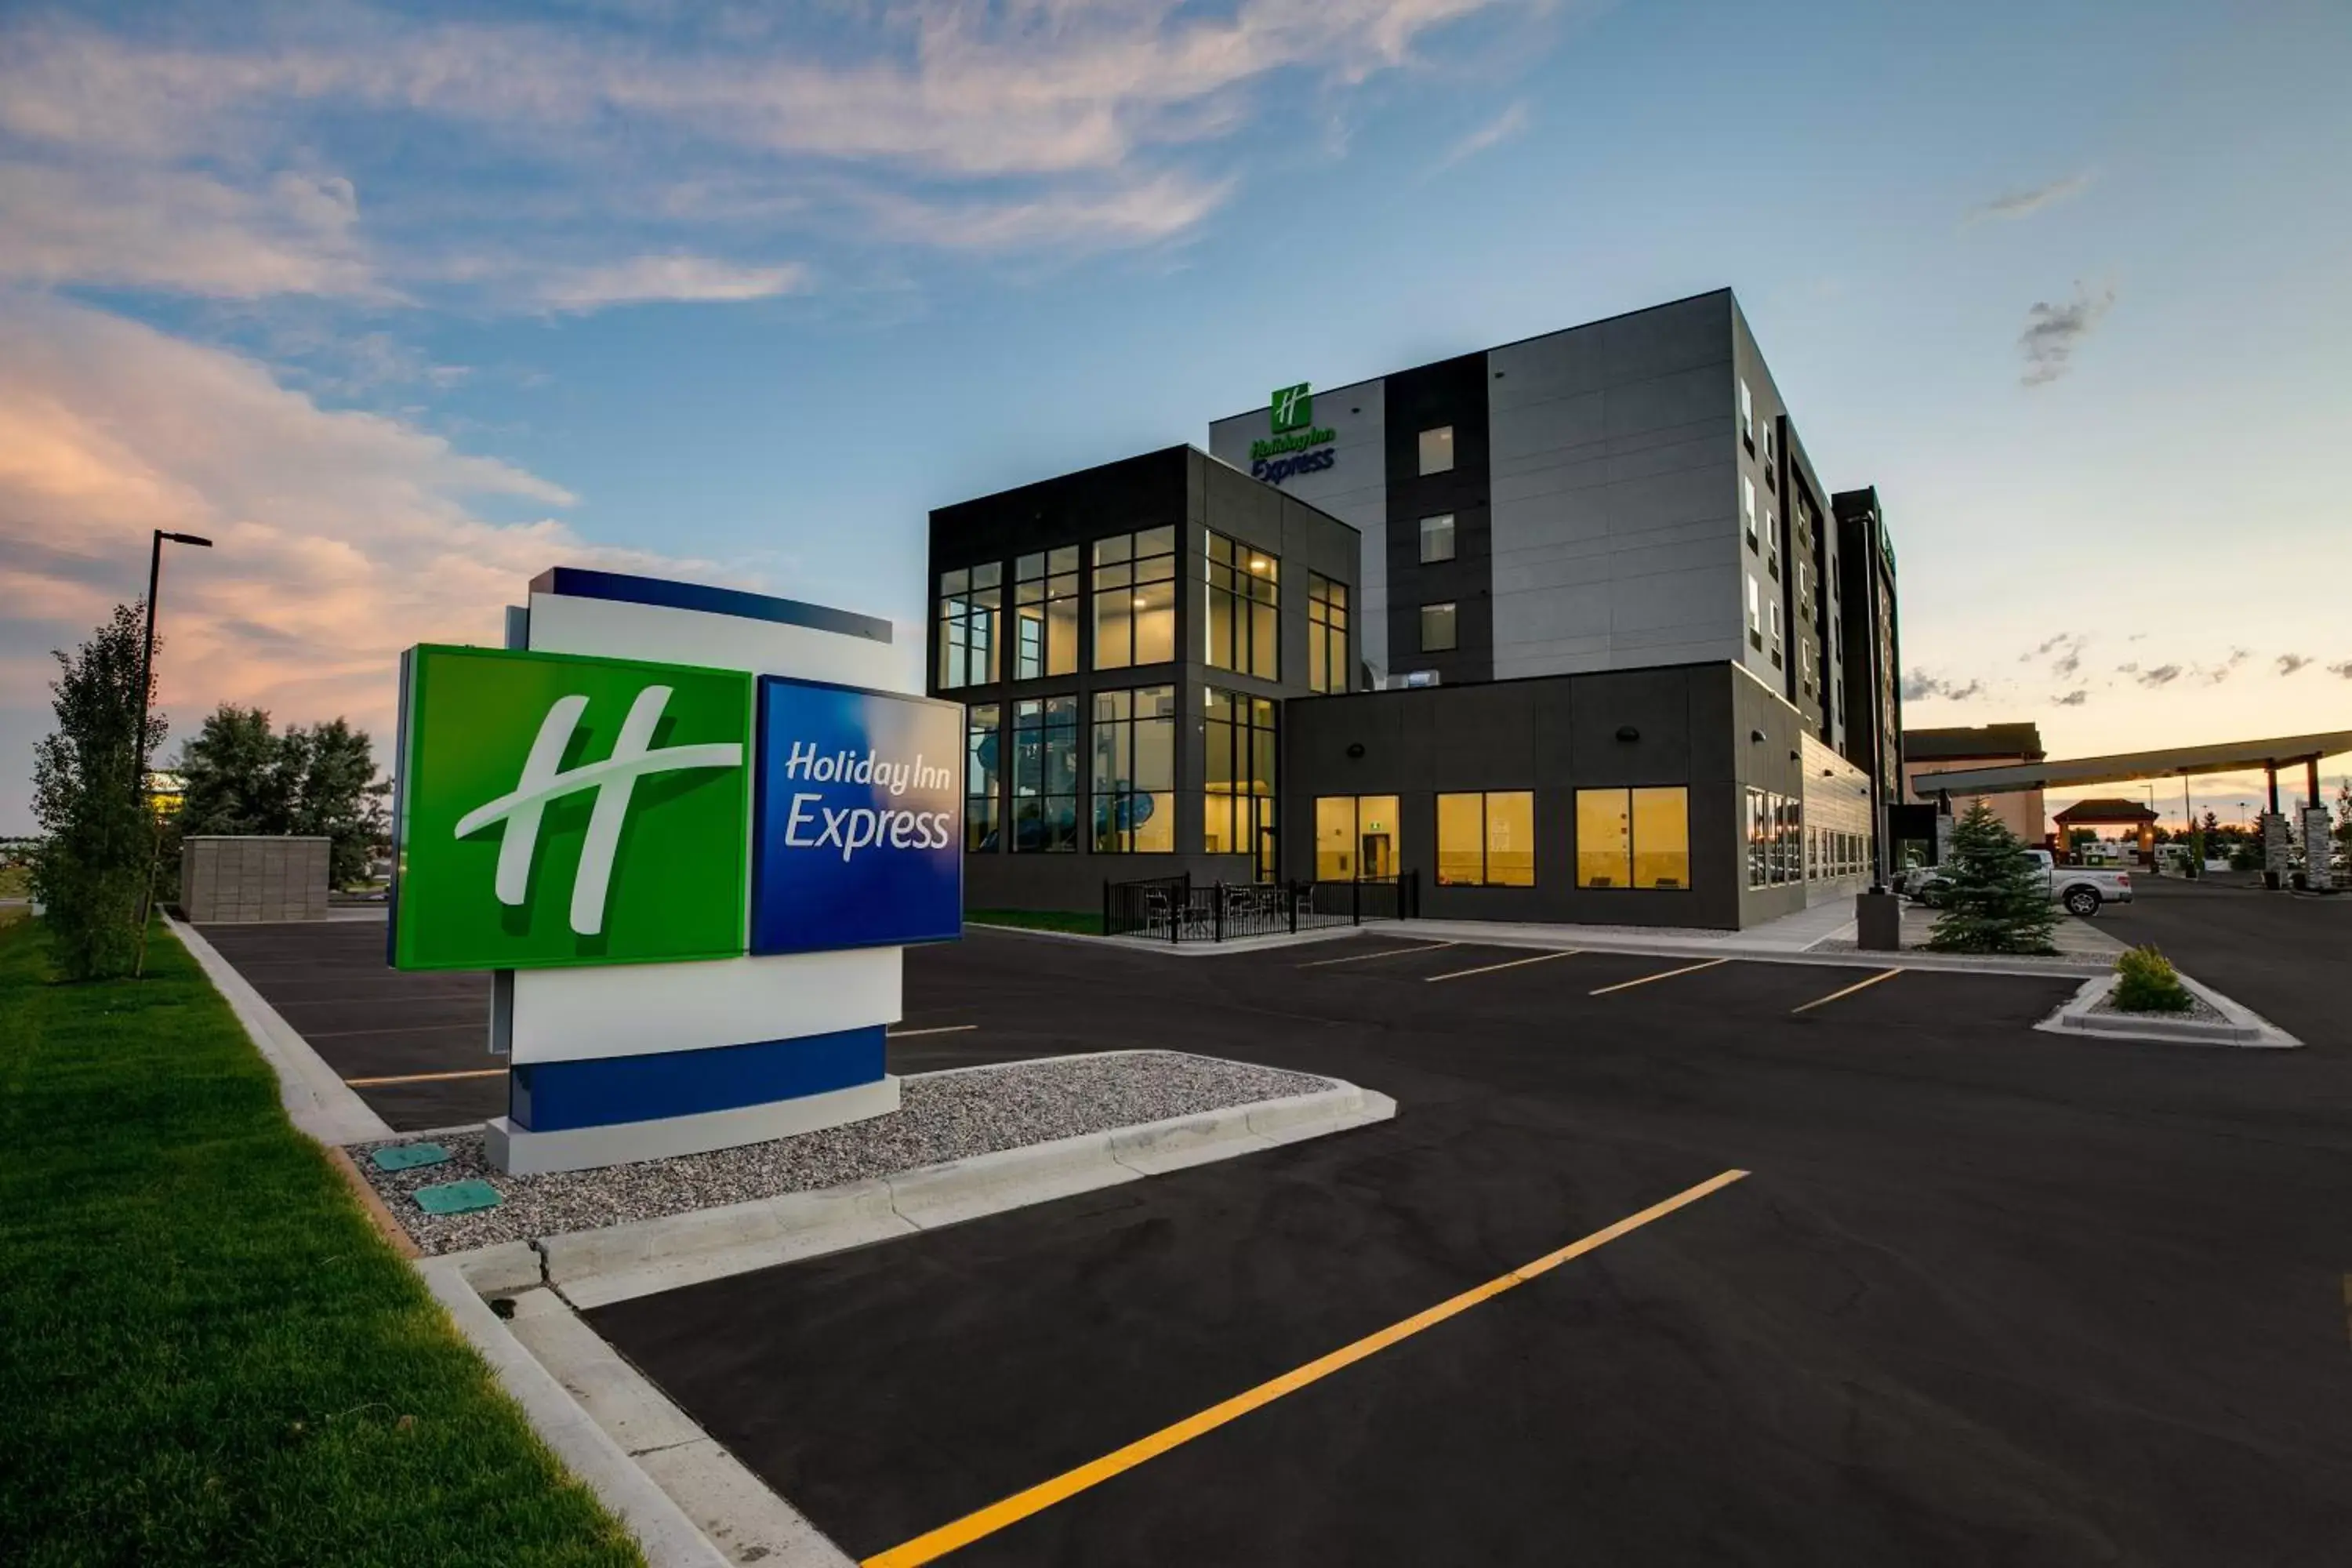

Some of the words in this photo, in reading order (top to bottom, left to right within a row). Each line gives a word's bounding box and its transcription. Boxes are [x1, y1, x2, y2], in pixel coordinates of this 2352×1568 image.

[1250, 434, 1310, 459] Holiday
[1310, 427, 1335, 445] Inn
[1251, 448, 1335, 485] Express
[786, 742, 909, 796] Holiday
[913, 753, 951, 790] Inn
[455, 684, 742, 935] H
[785, 793, 951, 863] Express
